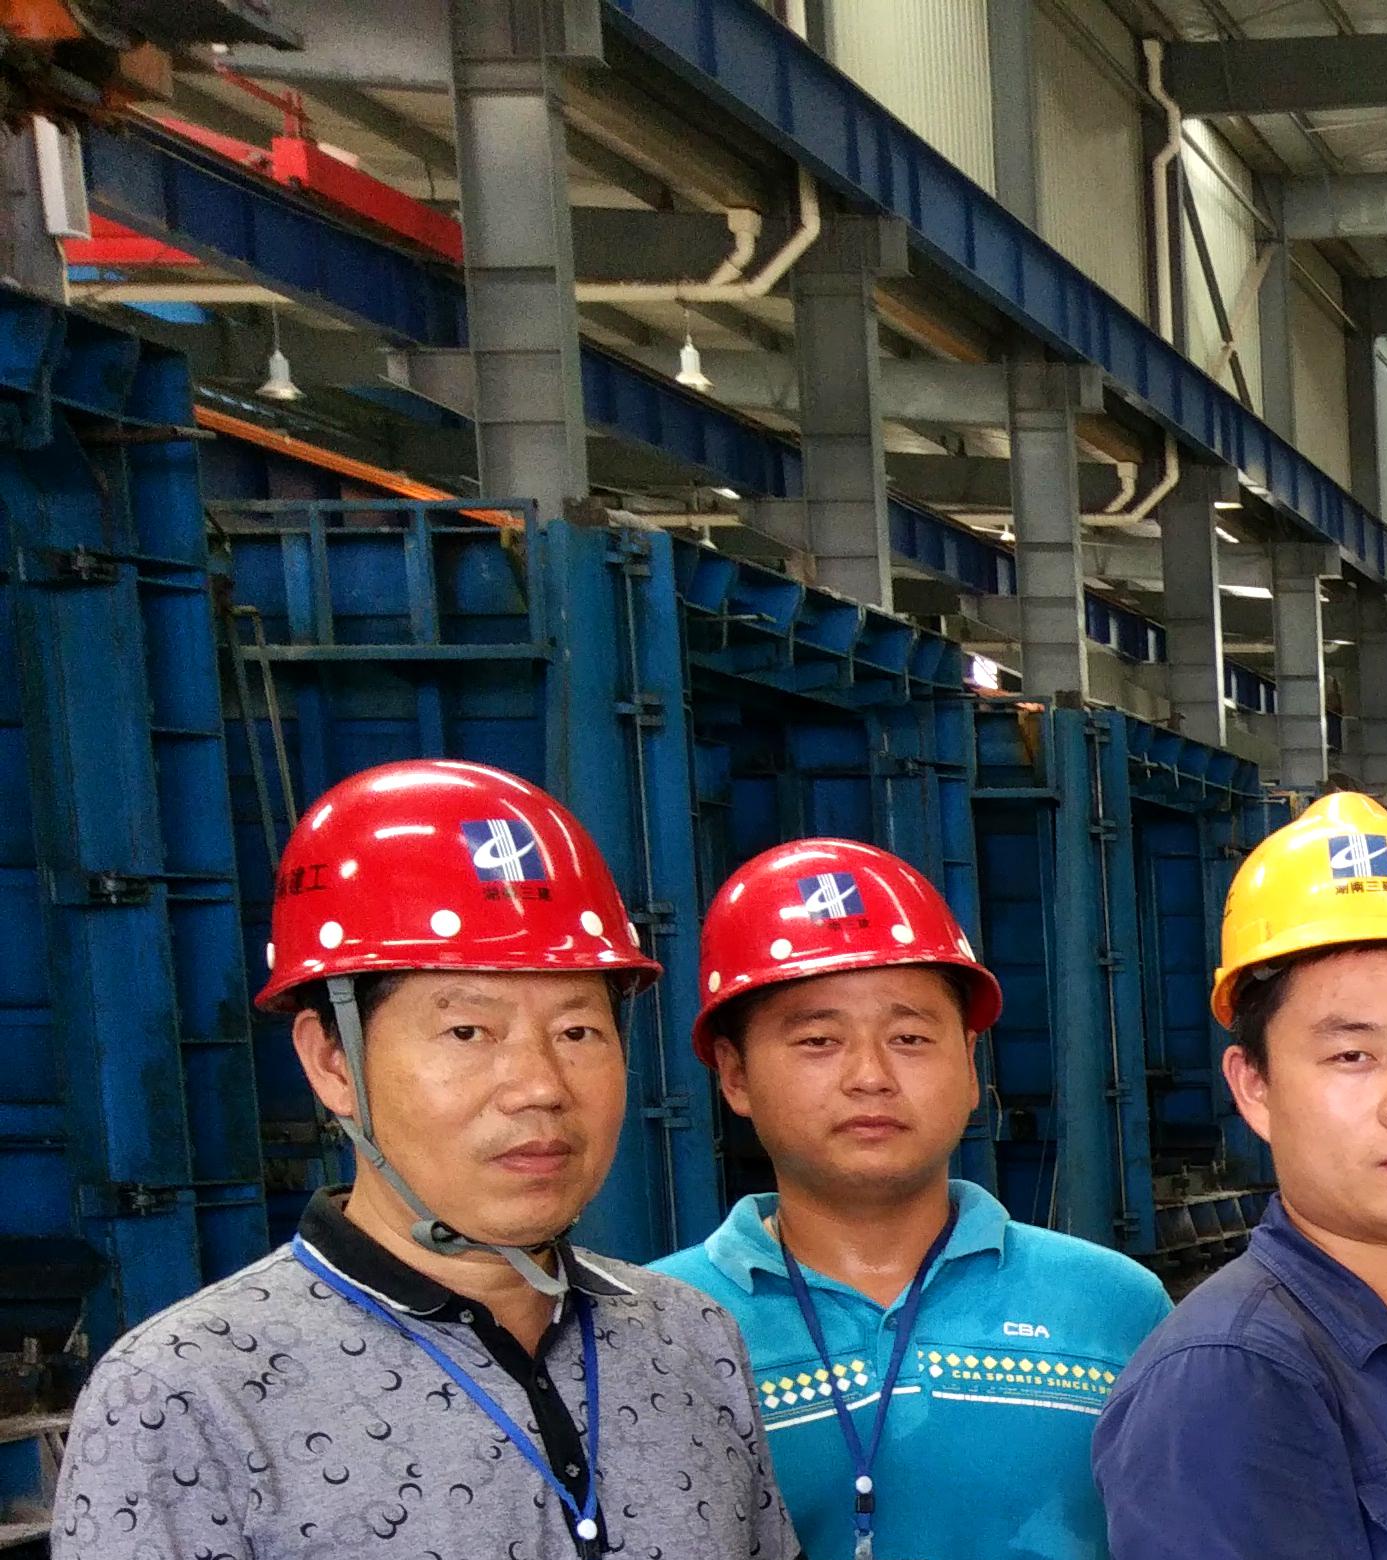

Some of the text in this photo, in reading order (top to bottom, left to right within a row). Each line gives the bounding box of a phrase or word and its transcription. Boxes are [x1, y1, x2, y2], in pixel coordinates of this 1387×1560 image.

[1003, 1321, 1050, 1339] CBA
[952, 1370, 982, 1381] CBA
[986, 1372, 1042, 1385] SPORTS
